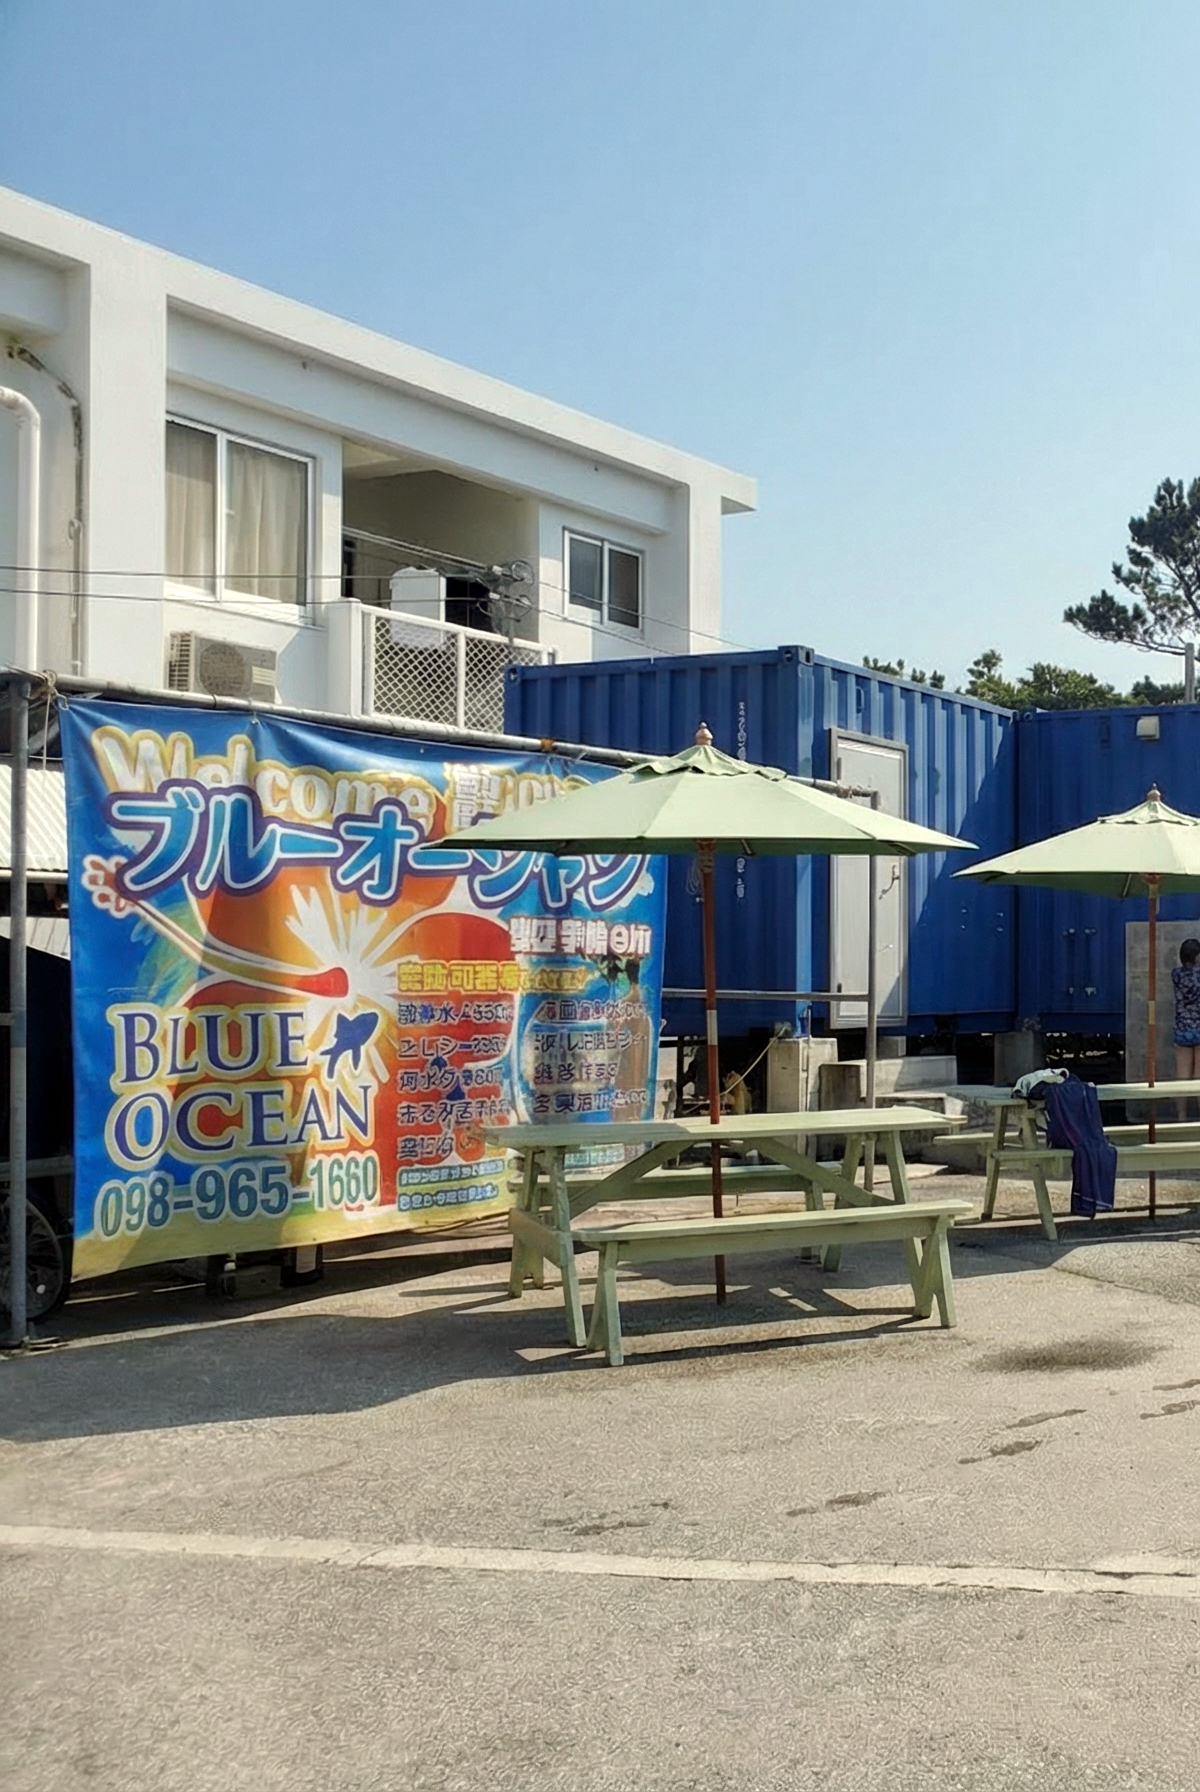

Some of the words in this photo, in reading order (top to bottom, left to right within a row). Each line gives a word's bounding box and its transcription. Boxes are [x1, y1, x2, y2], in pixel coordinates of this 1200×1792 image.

[94, 728, 435, 836] Welcome
[115, 1010, 310, 1084] BLUE
[103, 1084, 373, 1162] OCEAN
[100, 1155, 379, 1237] 098-965-1660
